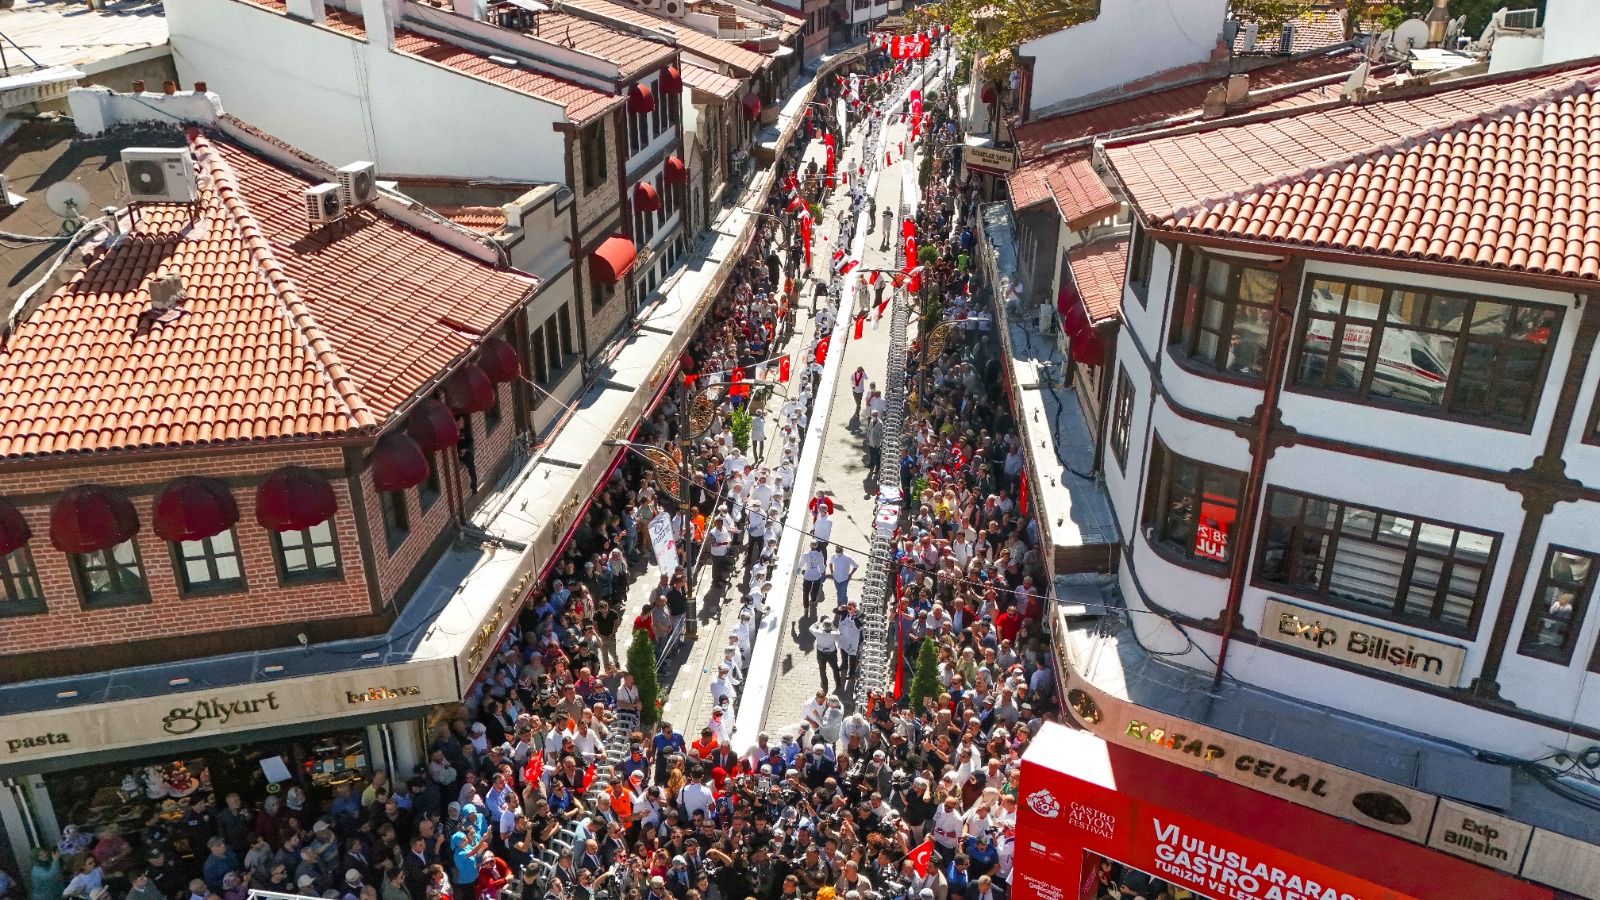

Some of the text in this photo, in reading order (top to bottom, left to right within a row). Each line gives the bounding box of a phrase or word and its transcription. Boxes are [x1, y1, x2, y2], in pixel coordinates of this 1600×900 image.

[1346, 630, 1443, 676] Bilişim
[345, 684, 421, 705] baklava
[6, 730, 71, 754] pasta
[1125, 719, 1328, 798] KASAP CELAL
[1068, 809, 1115, 833] AFYON
[1070, 801, 1116, 825] GASTRO
[1154, 858, 1205, 886] TURİZM
[1208, 879, 1227, 895] VE
[1155, 844, 1260, 893] GASTRO
[1181, 834, 1361, 900] ULUSLARARA
